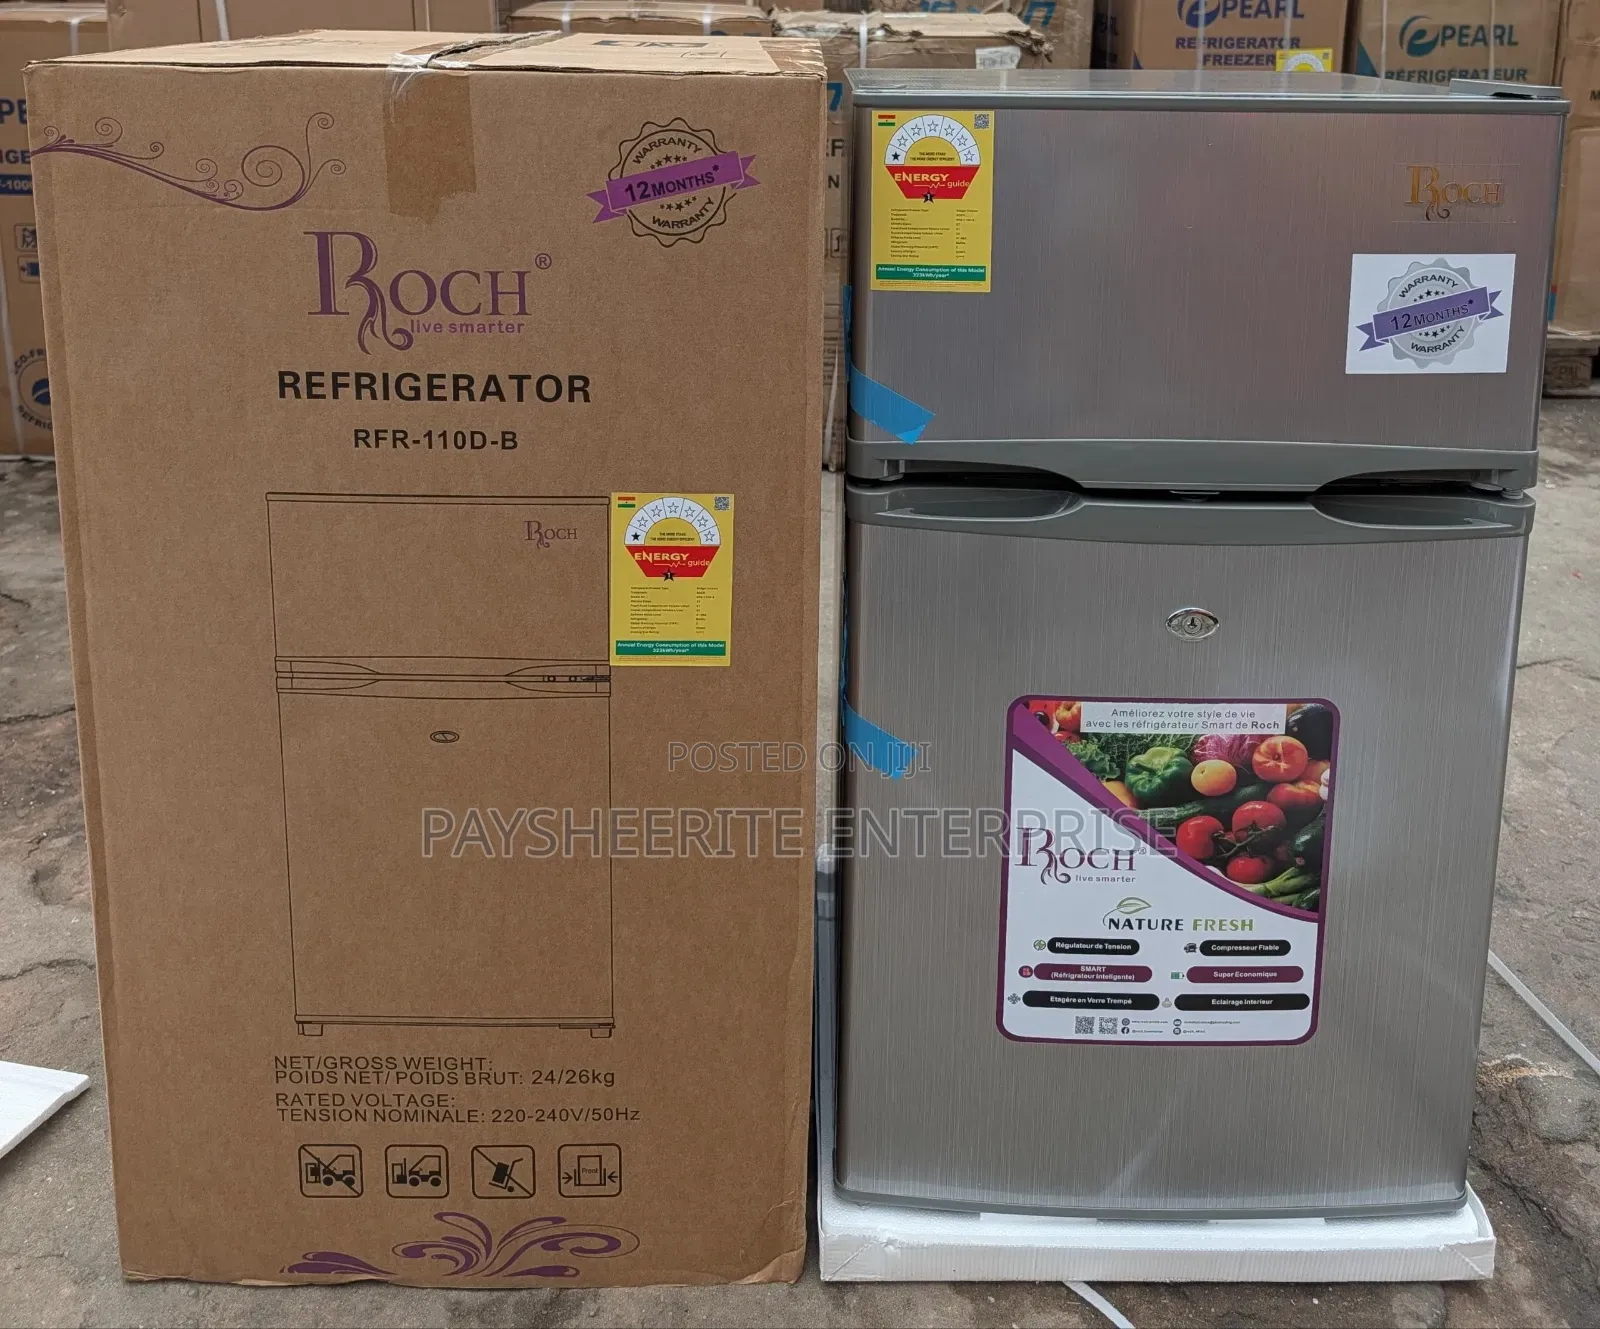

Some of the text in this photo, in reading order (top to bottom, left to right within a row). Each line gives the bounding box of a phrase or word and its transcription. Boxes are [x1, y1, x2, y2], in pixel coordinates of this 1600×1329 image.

[1202, 54, 1276, 66] FREEZER
[632, 137, 703, 165] WARRANTY
[625, 180, 650, 202] 12
[947, 180, 970, 188] guide
[652, 197, 715, 229] WARRANTY
[1399, 274, 1459, 299] WARRANTY
[410, 319, 525, 334] live smarter
[1390, 313, 1412, 331] 12
[1411, 325, 1465, 353] WARRANTY
[278, 370, 592, 403] REFRIGERATOR
[353, 428, 518, 450] RFR-110D-B
[524, 520, 578, 549] ROCH
[688, 559, 710, 567] guide
[1111, 708, 1255, 720] Améliorez votre style de vie
[1086, 720, 1111, 728] avec
[1113, 719, 1129, 728] les
[1201, 720, 1233, 729] Smart
[1235, 720, 1248, 729] de
[1251, 721, 1280, 729] Roch
[1076, 874, 1136, 883] live smarter
[1108, 917, 1254, 931] NATURE FRESH
[1055, 941, 1093, 950] Régulateur
[1211, 944, 1257, 952] Compresseur
[1213, 971, 1233, 979] Super
[1106, 997, 1133, 1006] Trempé
[274, 1055, 493, 1072] NET/GROSS WEIGHT:
[274, 1070, 338, 1085] POIDS
[396, 1071, 459, 1085] POIDS
[464, 1072, 523, 1085] BRUT:
[531, 1069, 616, 1088] 24/26kg
[275, 1093, 455, 1108] RATED VOLTAGE:
[277, 1107, 640, 1124] TENSION NOMINALE: 220-240V/50Hz
